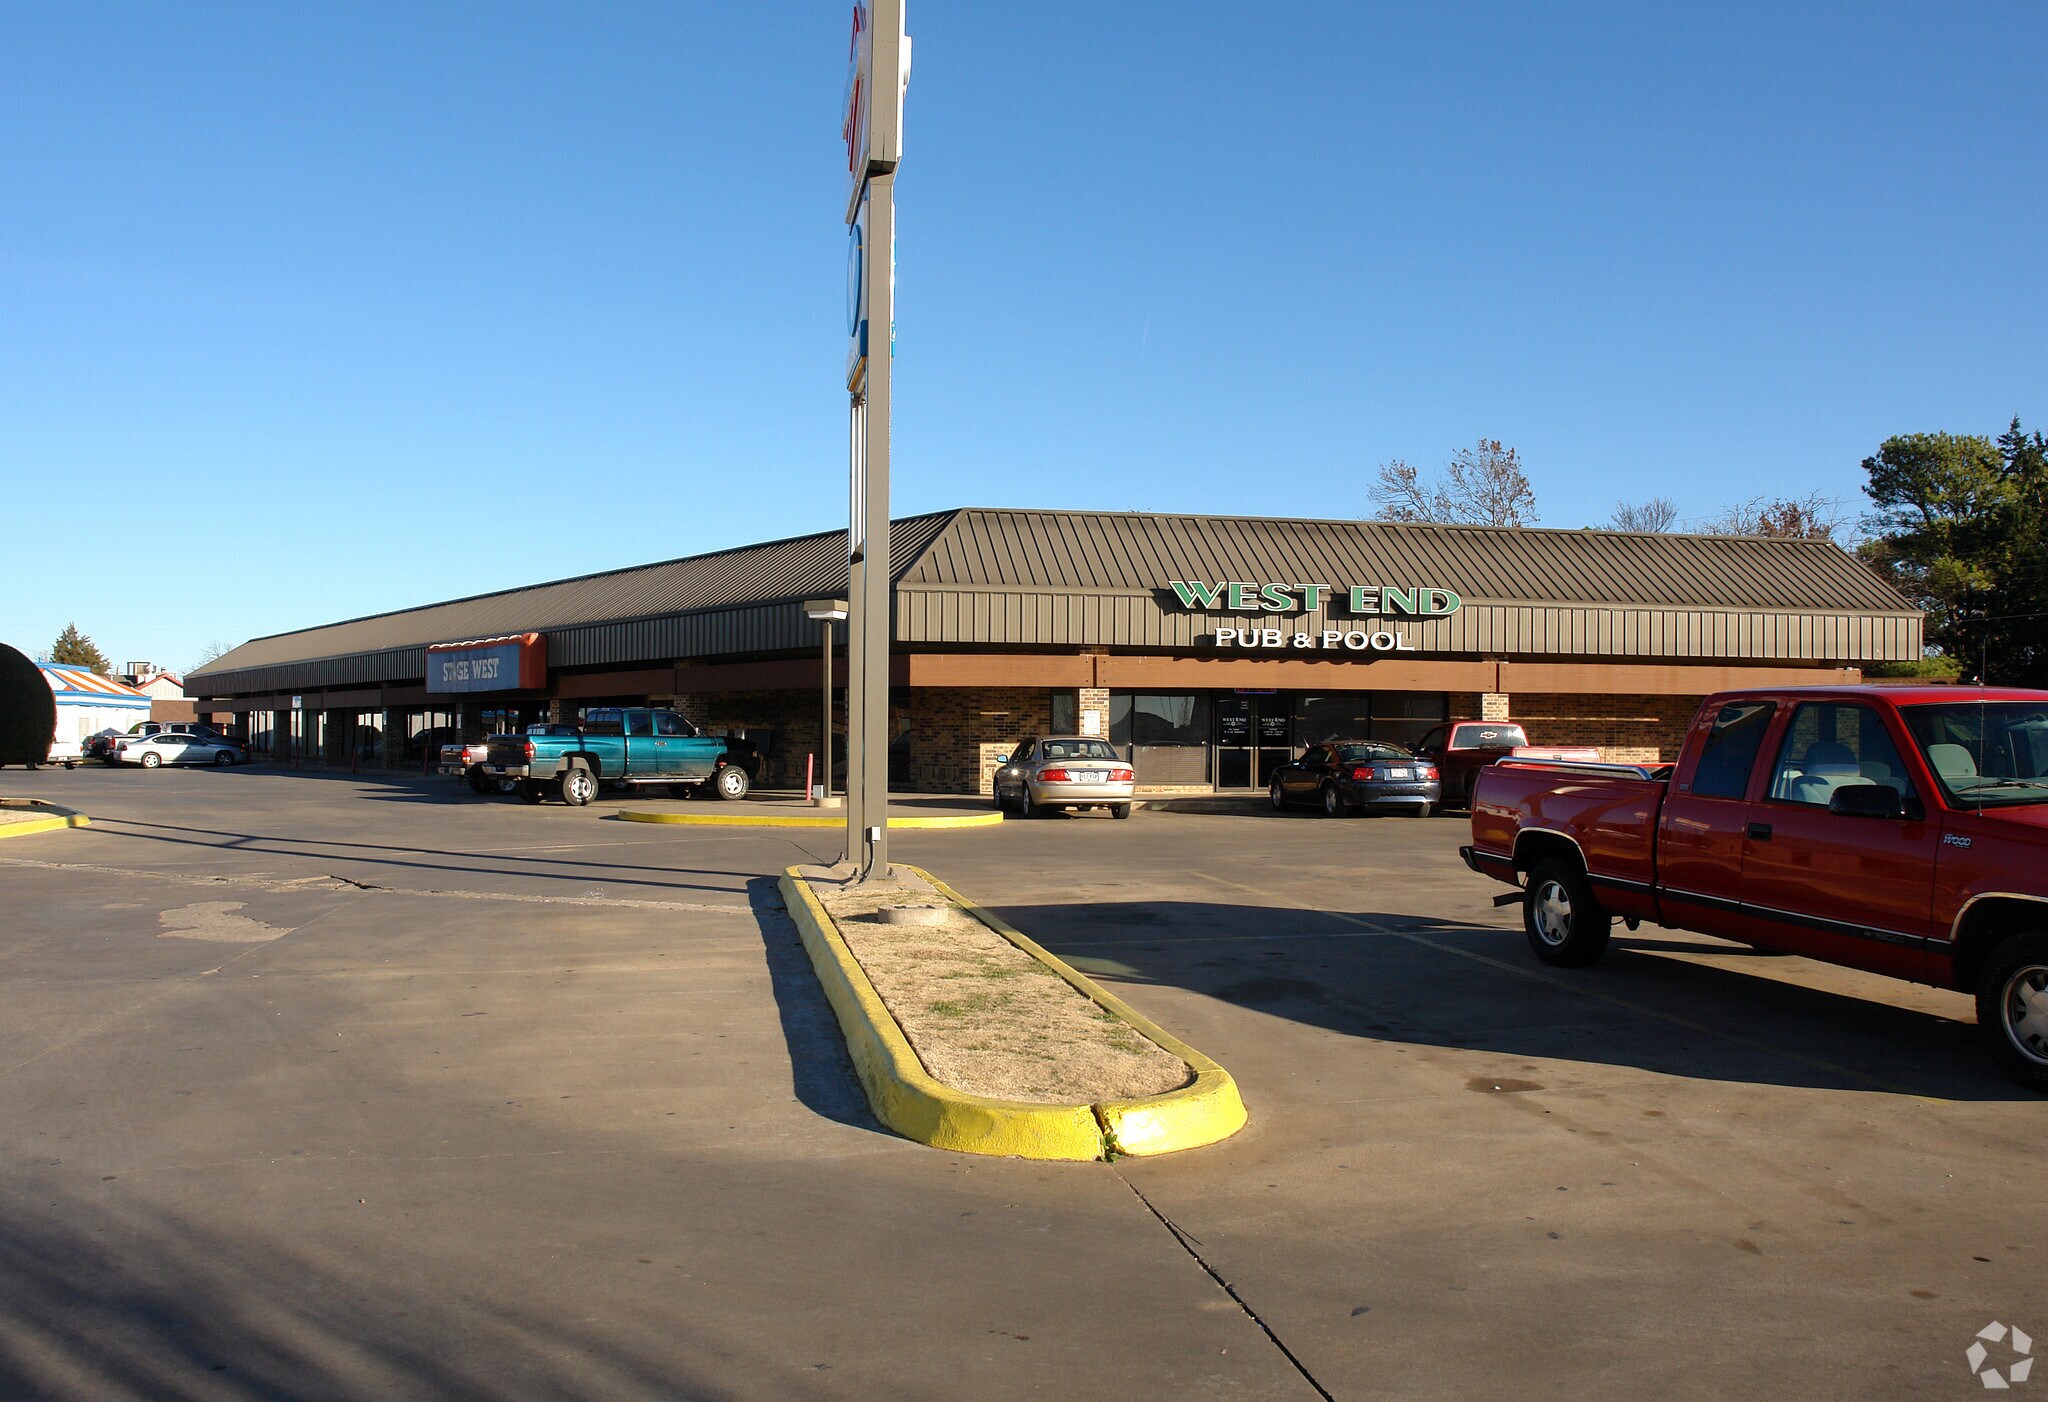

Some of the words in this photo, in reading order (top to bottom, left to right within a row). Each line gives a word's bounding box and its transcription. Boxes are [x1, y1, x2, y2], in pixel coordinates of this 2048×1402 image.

[1168, 580, 1331, 612] WEST
[1350, 585, 1462, 615] END
[1214, 628, 1283, 648] PUB
[1293, 632, 1312, 649] &
[1322, 630, 1415, 652] POOL
[472, 658, 499, 679] WEST
